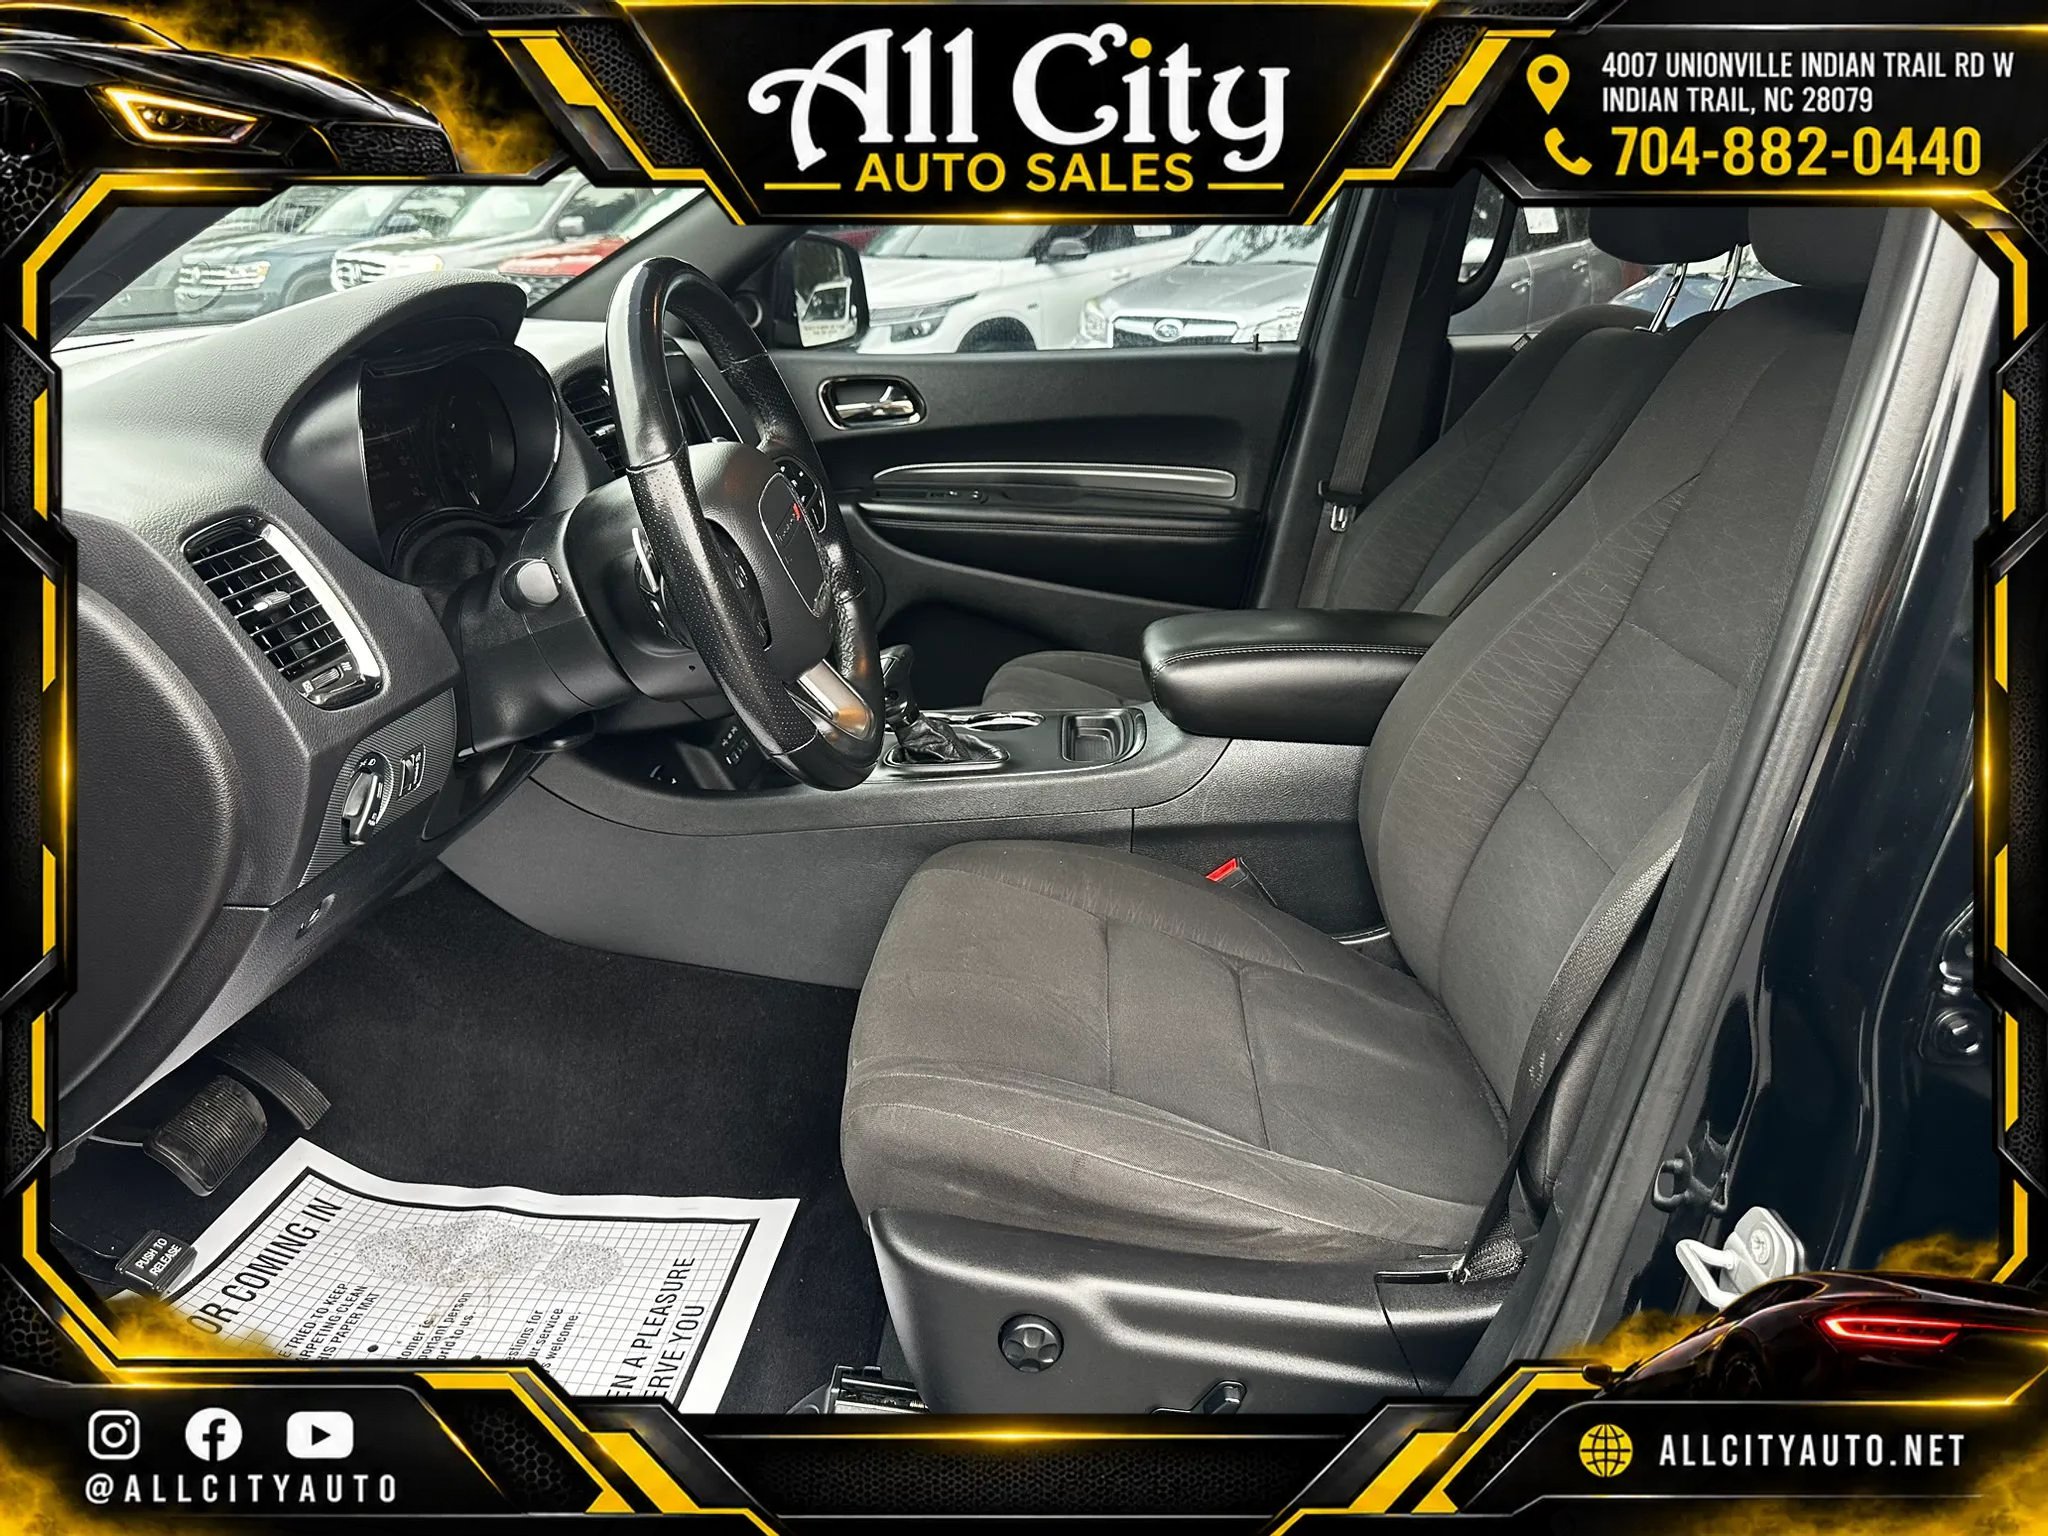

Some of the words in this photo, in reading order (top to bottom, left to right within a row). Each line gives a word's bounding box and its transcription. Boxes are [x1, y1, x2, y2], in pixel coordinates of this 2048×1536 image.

[135, 1248, 158, 1269] PUSH
[153, 1238, 168, 1249] TO
[149, 1244, 182, 1276] RELEASE
[221, 1221, 320, 1302] COMING
[301, 1196, 343, 1223] IN
[336, 1286, 368, 1313] CLEAN
[443, 1292, 473, 1323] person
[630, 1257, 696, 1349] PLEASURE
[285, 1321, 317, 1349] TRIED
[310, 1307, 329, 1320] TO
[323, 1283, 349, 1306] KEEP
[330, 1312, 363, 1344] PAPER
[356, 1292, 380, 1311] MAT
[418, 1319, 434, 1329] is
[526, 1310, 543, 1324] for
[536, 1308, 563, 1345] service
[668, 1305, 705, 1343] YOU
[449, 1329, 464, 1339] to
[622, 1356, 647, 1369] A
